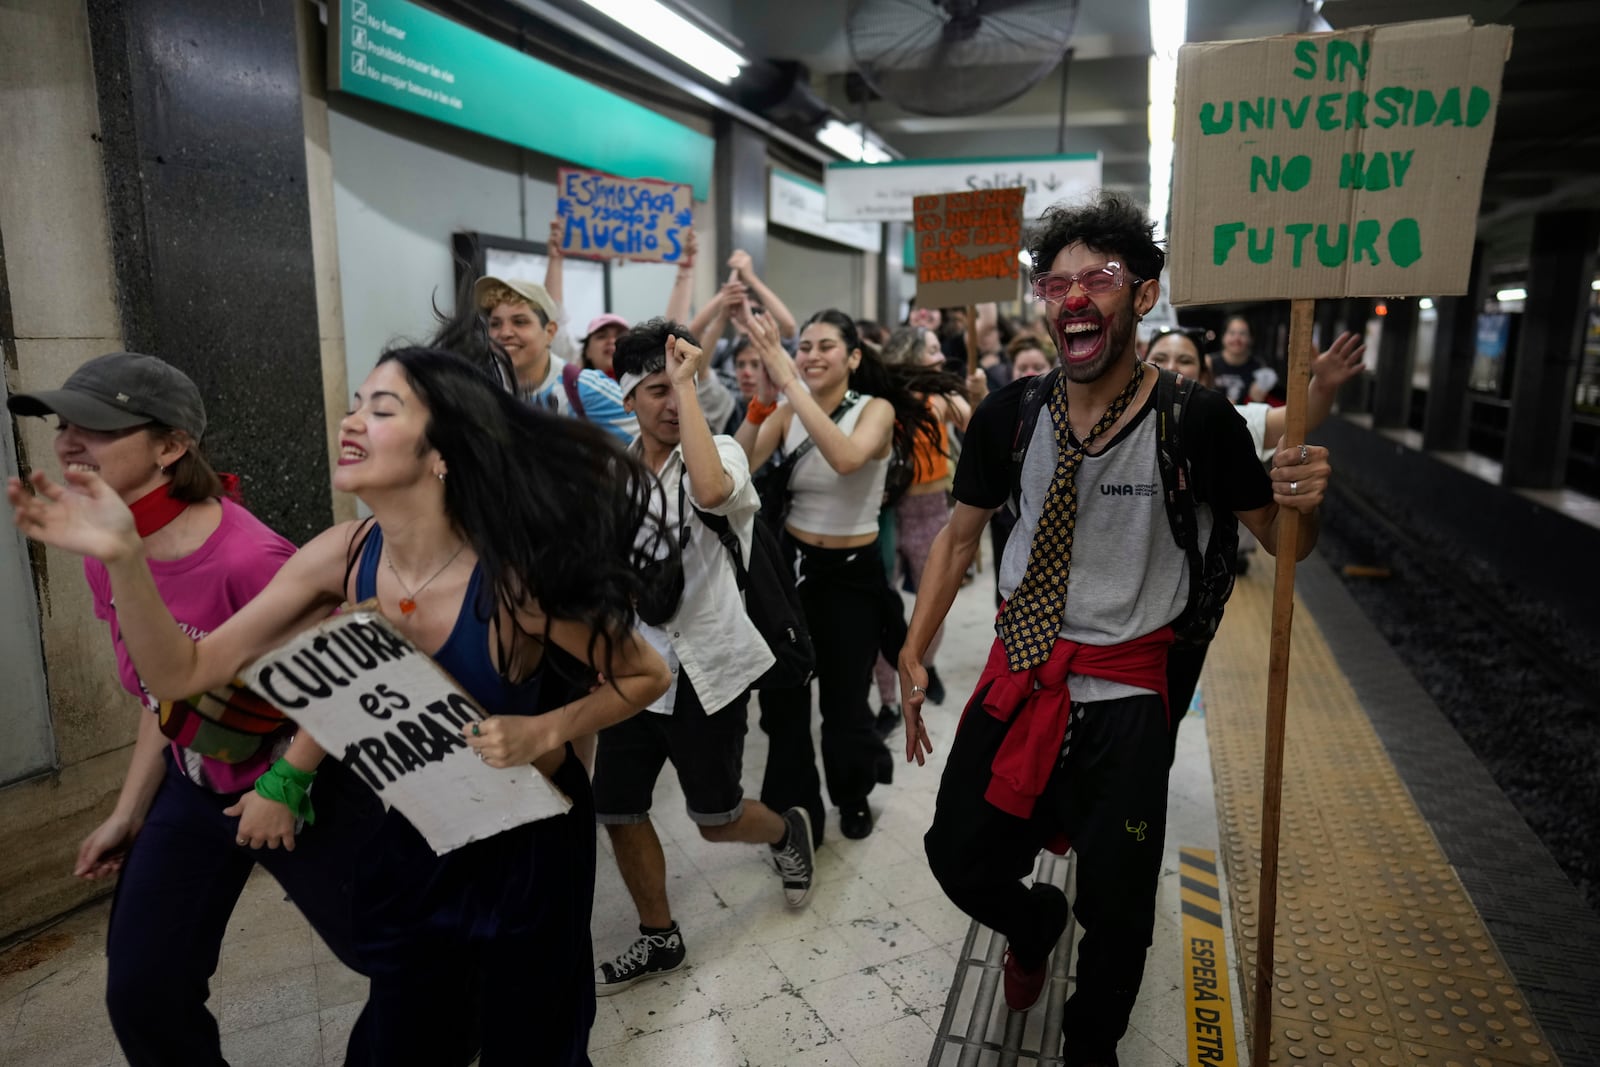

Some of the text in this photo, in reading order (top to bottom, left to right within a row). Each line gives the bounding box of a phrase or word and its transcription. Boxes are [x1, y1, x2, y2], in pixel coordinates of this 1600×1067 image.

[1293, 39, 1370, 82] SIN
[1199, 85, 1491, 135] UNIVERSIDAD
[966, 172, 1037, 193] Salida
[1250, 149, 1415, 193] NO HAY
[562, 215, 682, 262] MUCHOS
[1212, 217, 1423, 268] FUTURO
[1100, 484, 1134, 496] UNA
[259, 620, 415, 709] CULTURA
[1191, 936, 1225, 1002] ESPERÁ
